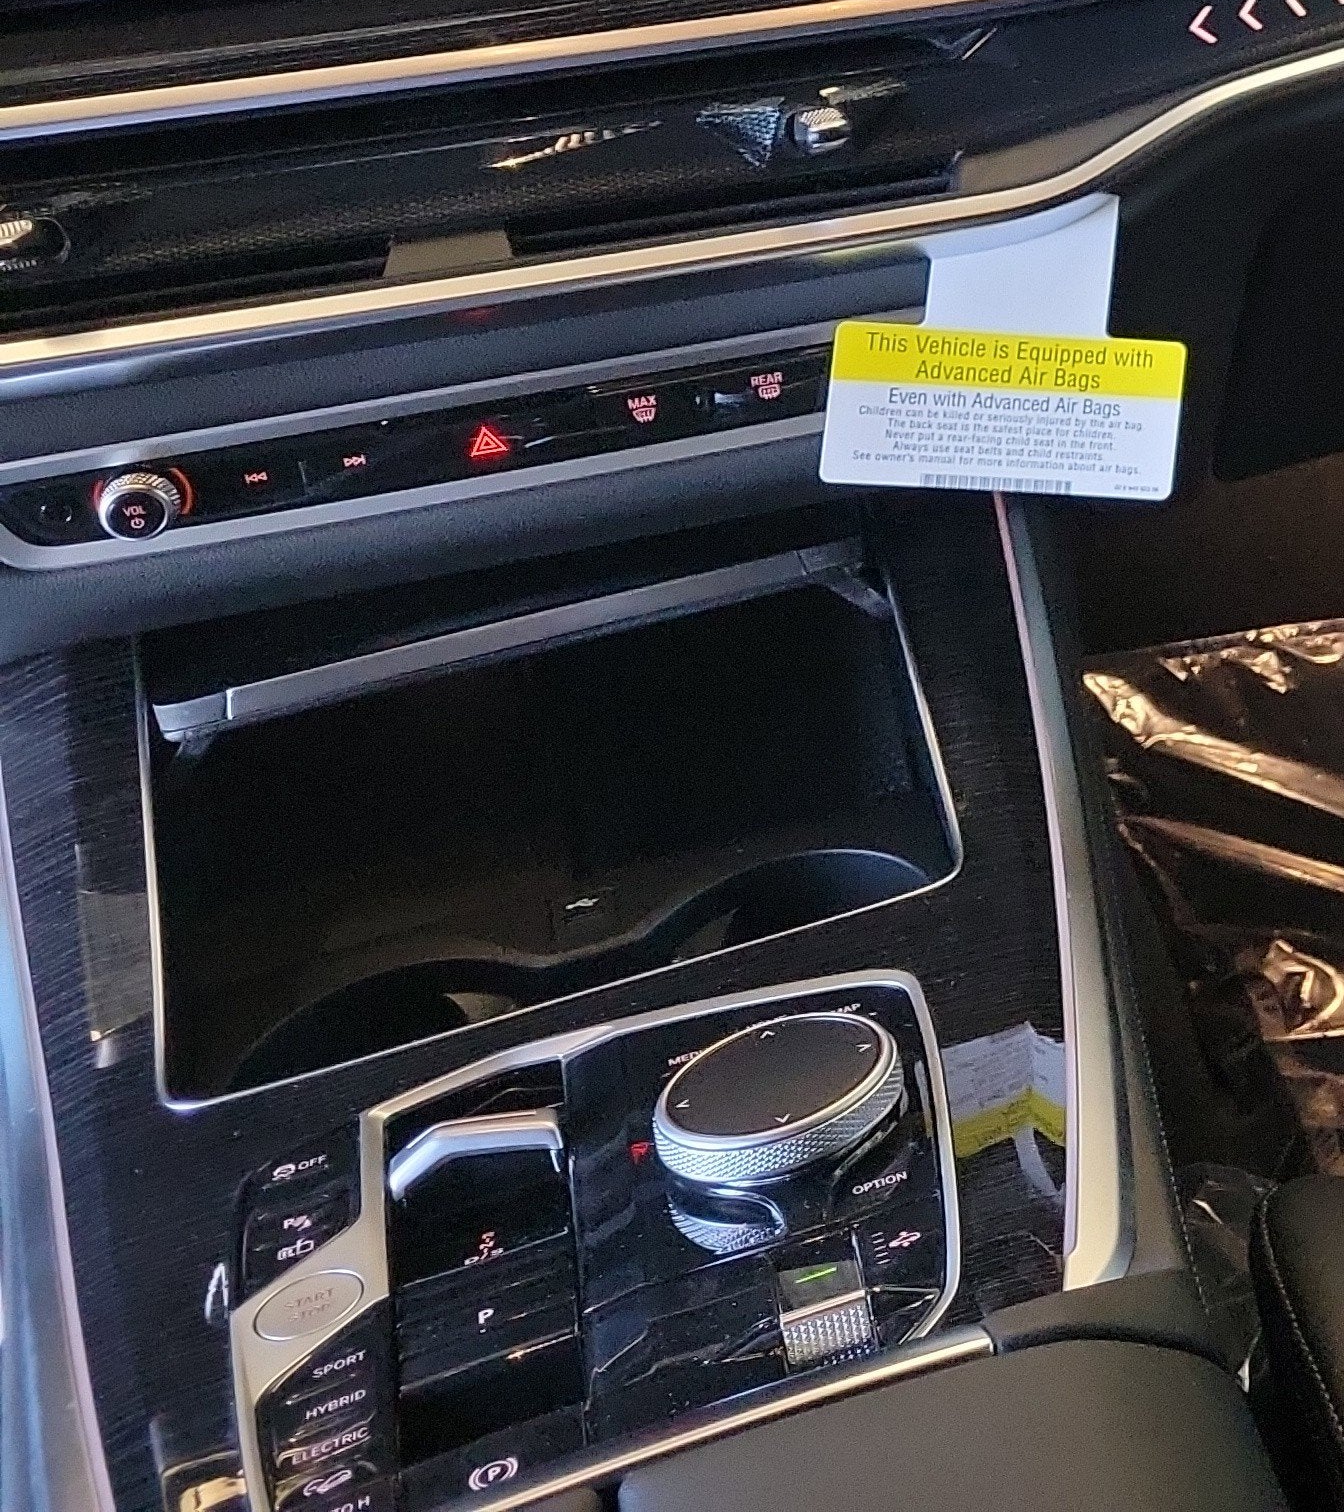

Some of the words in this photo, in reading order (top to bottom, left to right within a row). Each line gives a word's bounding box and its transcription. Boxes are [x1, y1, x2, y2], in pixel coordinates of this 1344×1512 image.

[866, 332, 908, 353] This
[916, 334, 986, 357] Vehicle
[993, 340, 1009, 359] is
[1017, 341, 1107, 367] Equipped
[1114, 348, 1153, 368] with
[751, 372, 783, 387] REAR
[915, 360, 1012, 383] Advanced
[1019, 366, 1048, 386] Air
[1054, 368, 1100, 392] Bags
[627, 395, 657, 410] MAX
[889, 388, 927, 405] Even
[933, 391, 966, 407] with
[971, 392, 1050, 412] Advanced
[1055, 397, 1078, 414] Air
[1083, 399, 1121, 418] Bags
[859, 405, 901, 416] Children
[906, 408, 923, 418] can
[927, 408, 939, 419] be
[943, 409, 969, 420] killed
[973, 411, 984, 420] or
[988, 412, 1033, 425] seriously
[1036, 415, 1071, 428] injured
[1075, 417, 1086, 429] by
[1090, 419, 1105, 428] the
[1108, 420, 1121, 429] air
[888, 418, 905, 428] The
[910, 419, 932, 429] back
[937, 421, 957, 431] seat
[961, 422, 969, 431] is
[974, 423, 989, 432] the
[992, 424, 1023, 435] safest
[1026, 426, 1052, 437] place
[1056, 428, 1069, 437] for
[885, 429, 914, 439] Never
[918, 431, 935, 442] put
[947, 433, 1002, 445] rear-facing
[1006, 436, 1030, 446] child
[1034, 438, 1054, 447] seat
[1058, 439, 1067, 447] in
[1071, 440, 1085, 448] the
[893, 441, 928, 453] Always
[933, 444, 949, 453] use
[954, 445, 974, 454] seat
[978, 445, 1002, 455] belts
[1006, 447, 1024, 457] and
[1028, 448, 1051, 458] child
[853, 450, 871, 461] See
[875, 452, 914, 463] owner's
[918, 454, 955, 464] manual
[960, 455, 973, 465] for
[977, 457, 1002, 466] more
[1006, 458, 1064, 470] information
[1068, 461, 1096, 472] about
[1100, 464, 1112, 473] air
[122, 505, 146, 516] VOL
[298, 1155, 327, 1170] OFF
[852, 1171, 908, 1195] OPTION
[284, 1288, 334, 1308] START
[478, 1308, 494, 1324] P
[312, 1350, 366, 1378] SPORT
[305, 1389, 367, 1421] HYBRID
[291, 1426, 370, 1466] ELECTRIC
